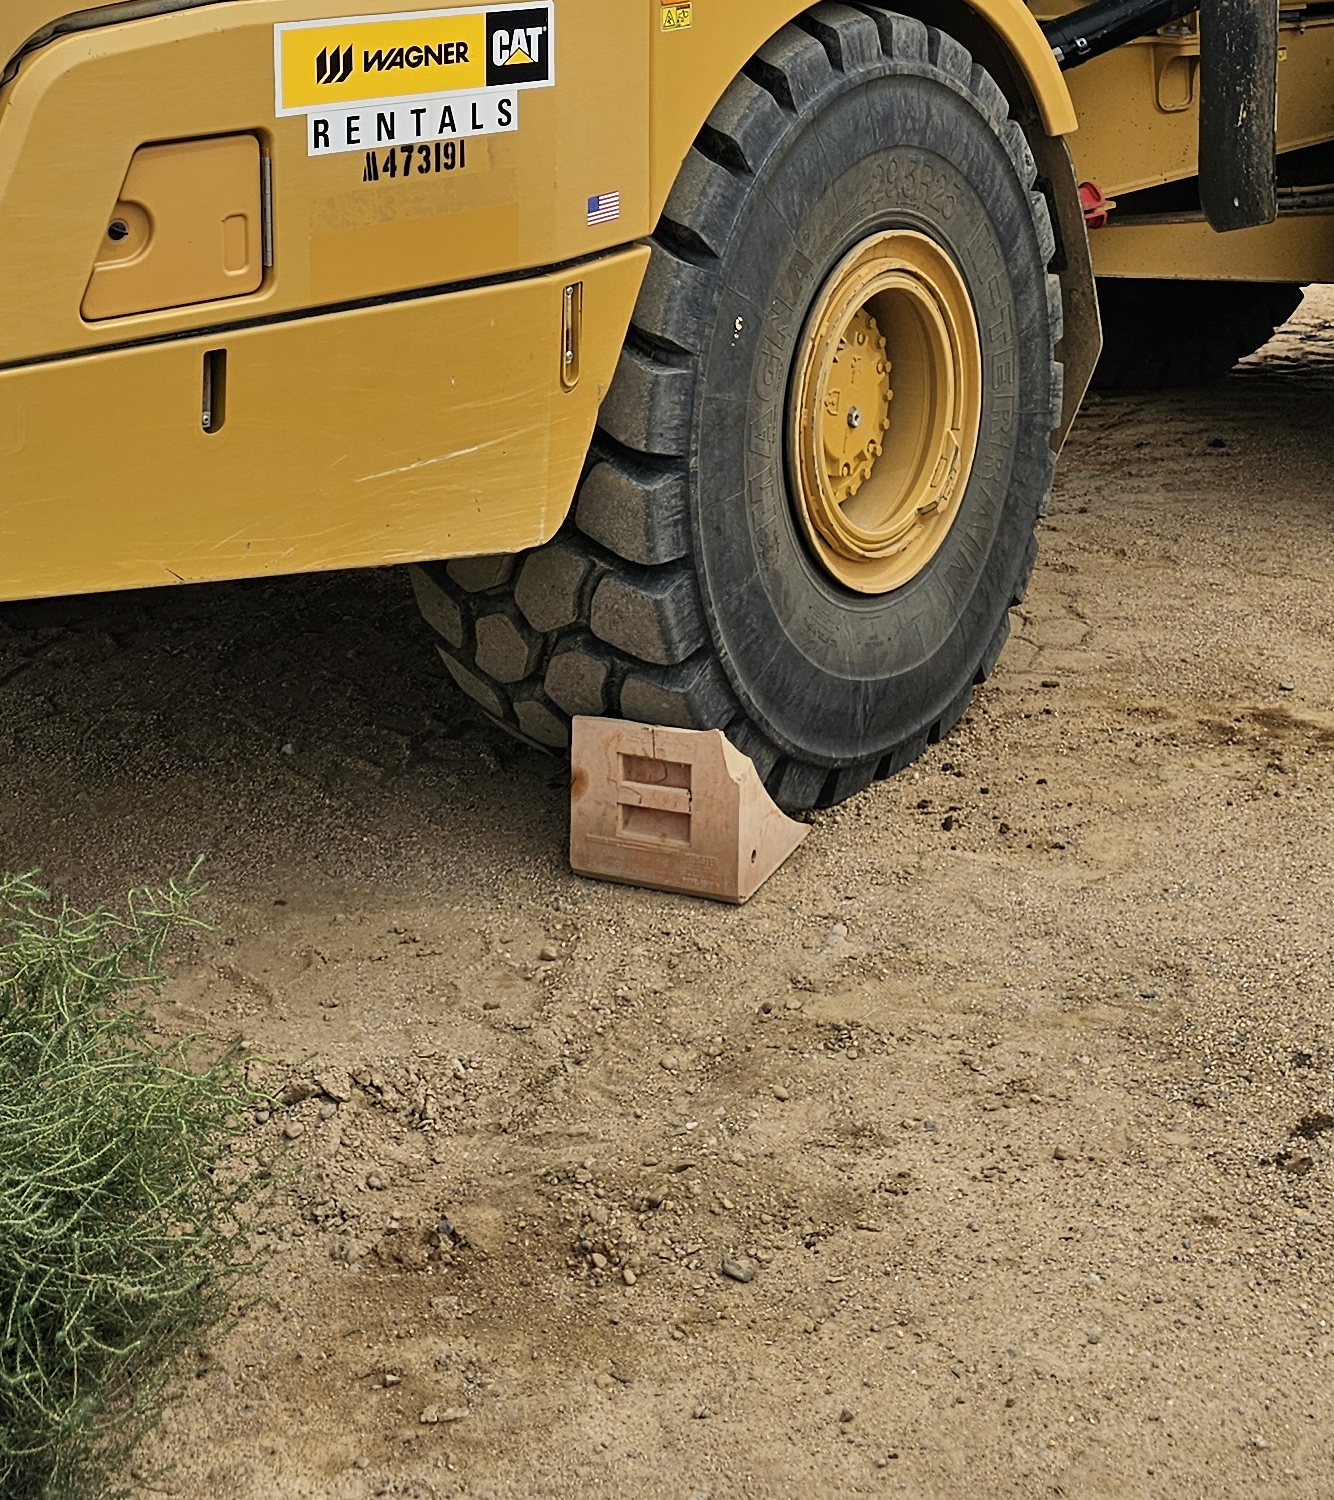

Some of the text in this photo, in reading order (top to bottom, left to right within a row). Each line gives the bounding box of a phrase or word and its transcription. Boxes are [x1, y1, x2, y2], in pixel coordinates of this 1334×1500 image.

[363, 26, 543, 73] WAGNER CAT
[312, 97, 513, 150] RENTALS
